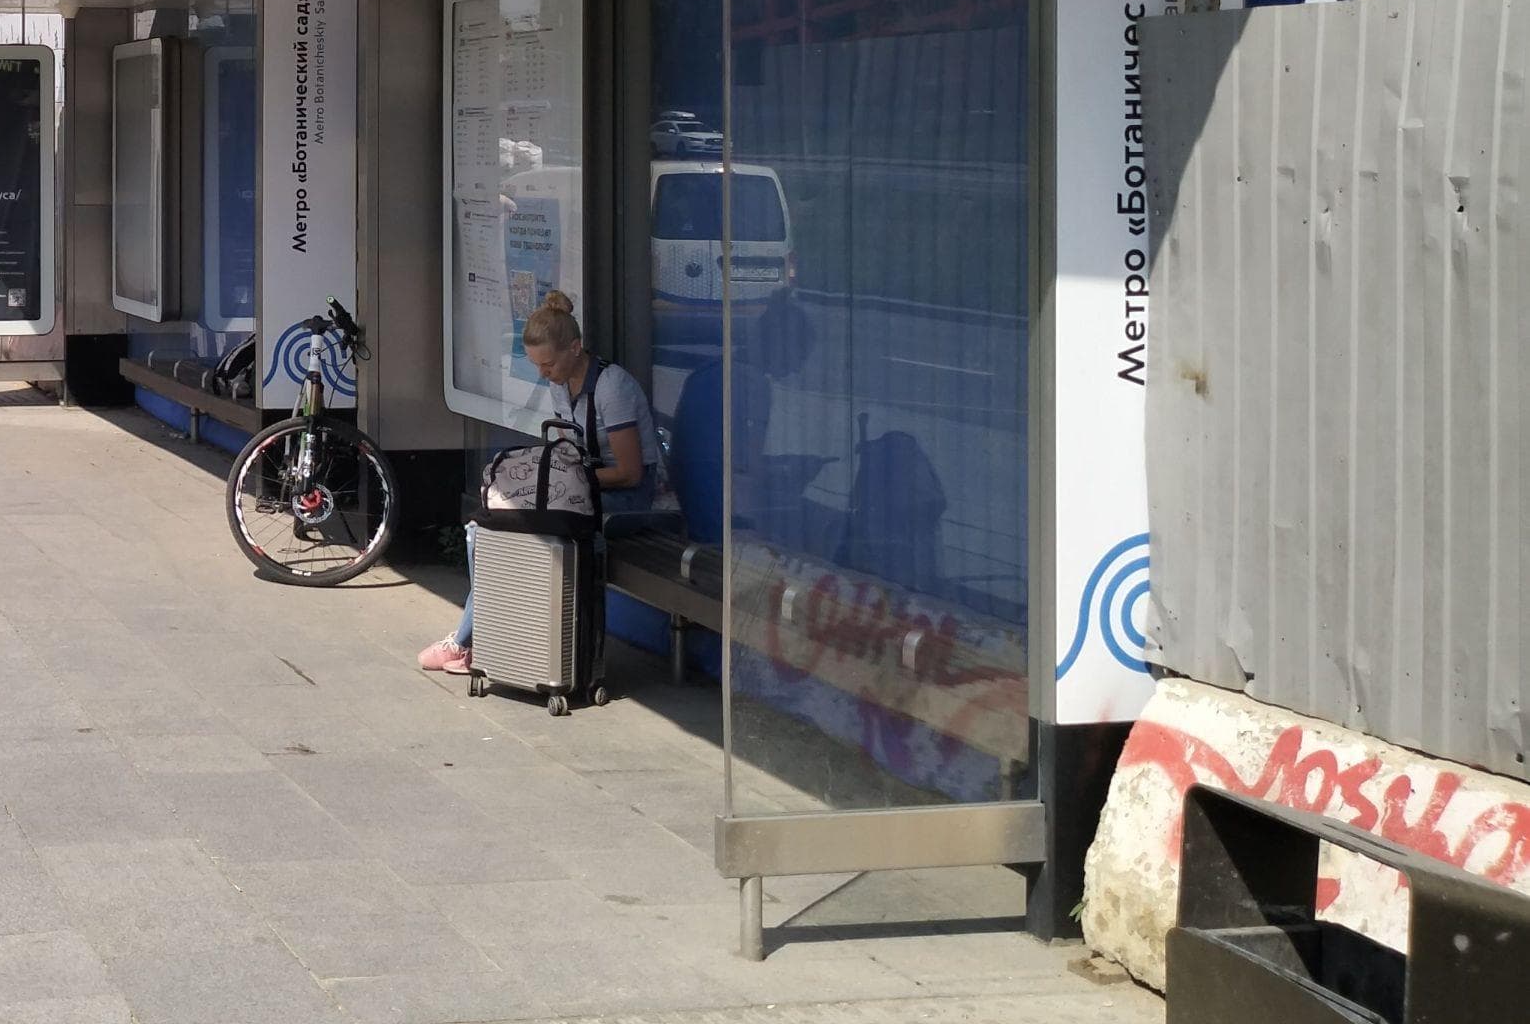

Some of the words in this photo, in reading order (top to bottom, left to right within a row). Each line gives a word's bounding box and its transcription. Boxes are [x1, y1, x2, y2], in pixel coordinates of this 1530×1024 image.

[314, 20, 326, 104] Botanicheskiy
[292, 41, 308, 183] «Ботанический
[314, 107, 325, 144] Metro
[292, 188, 310, 253] Метро
[1117, 248, 1149, 386] Метро
